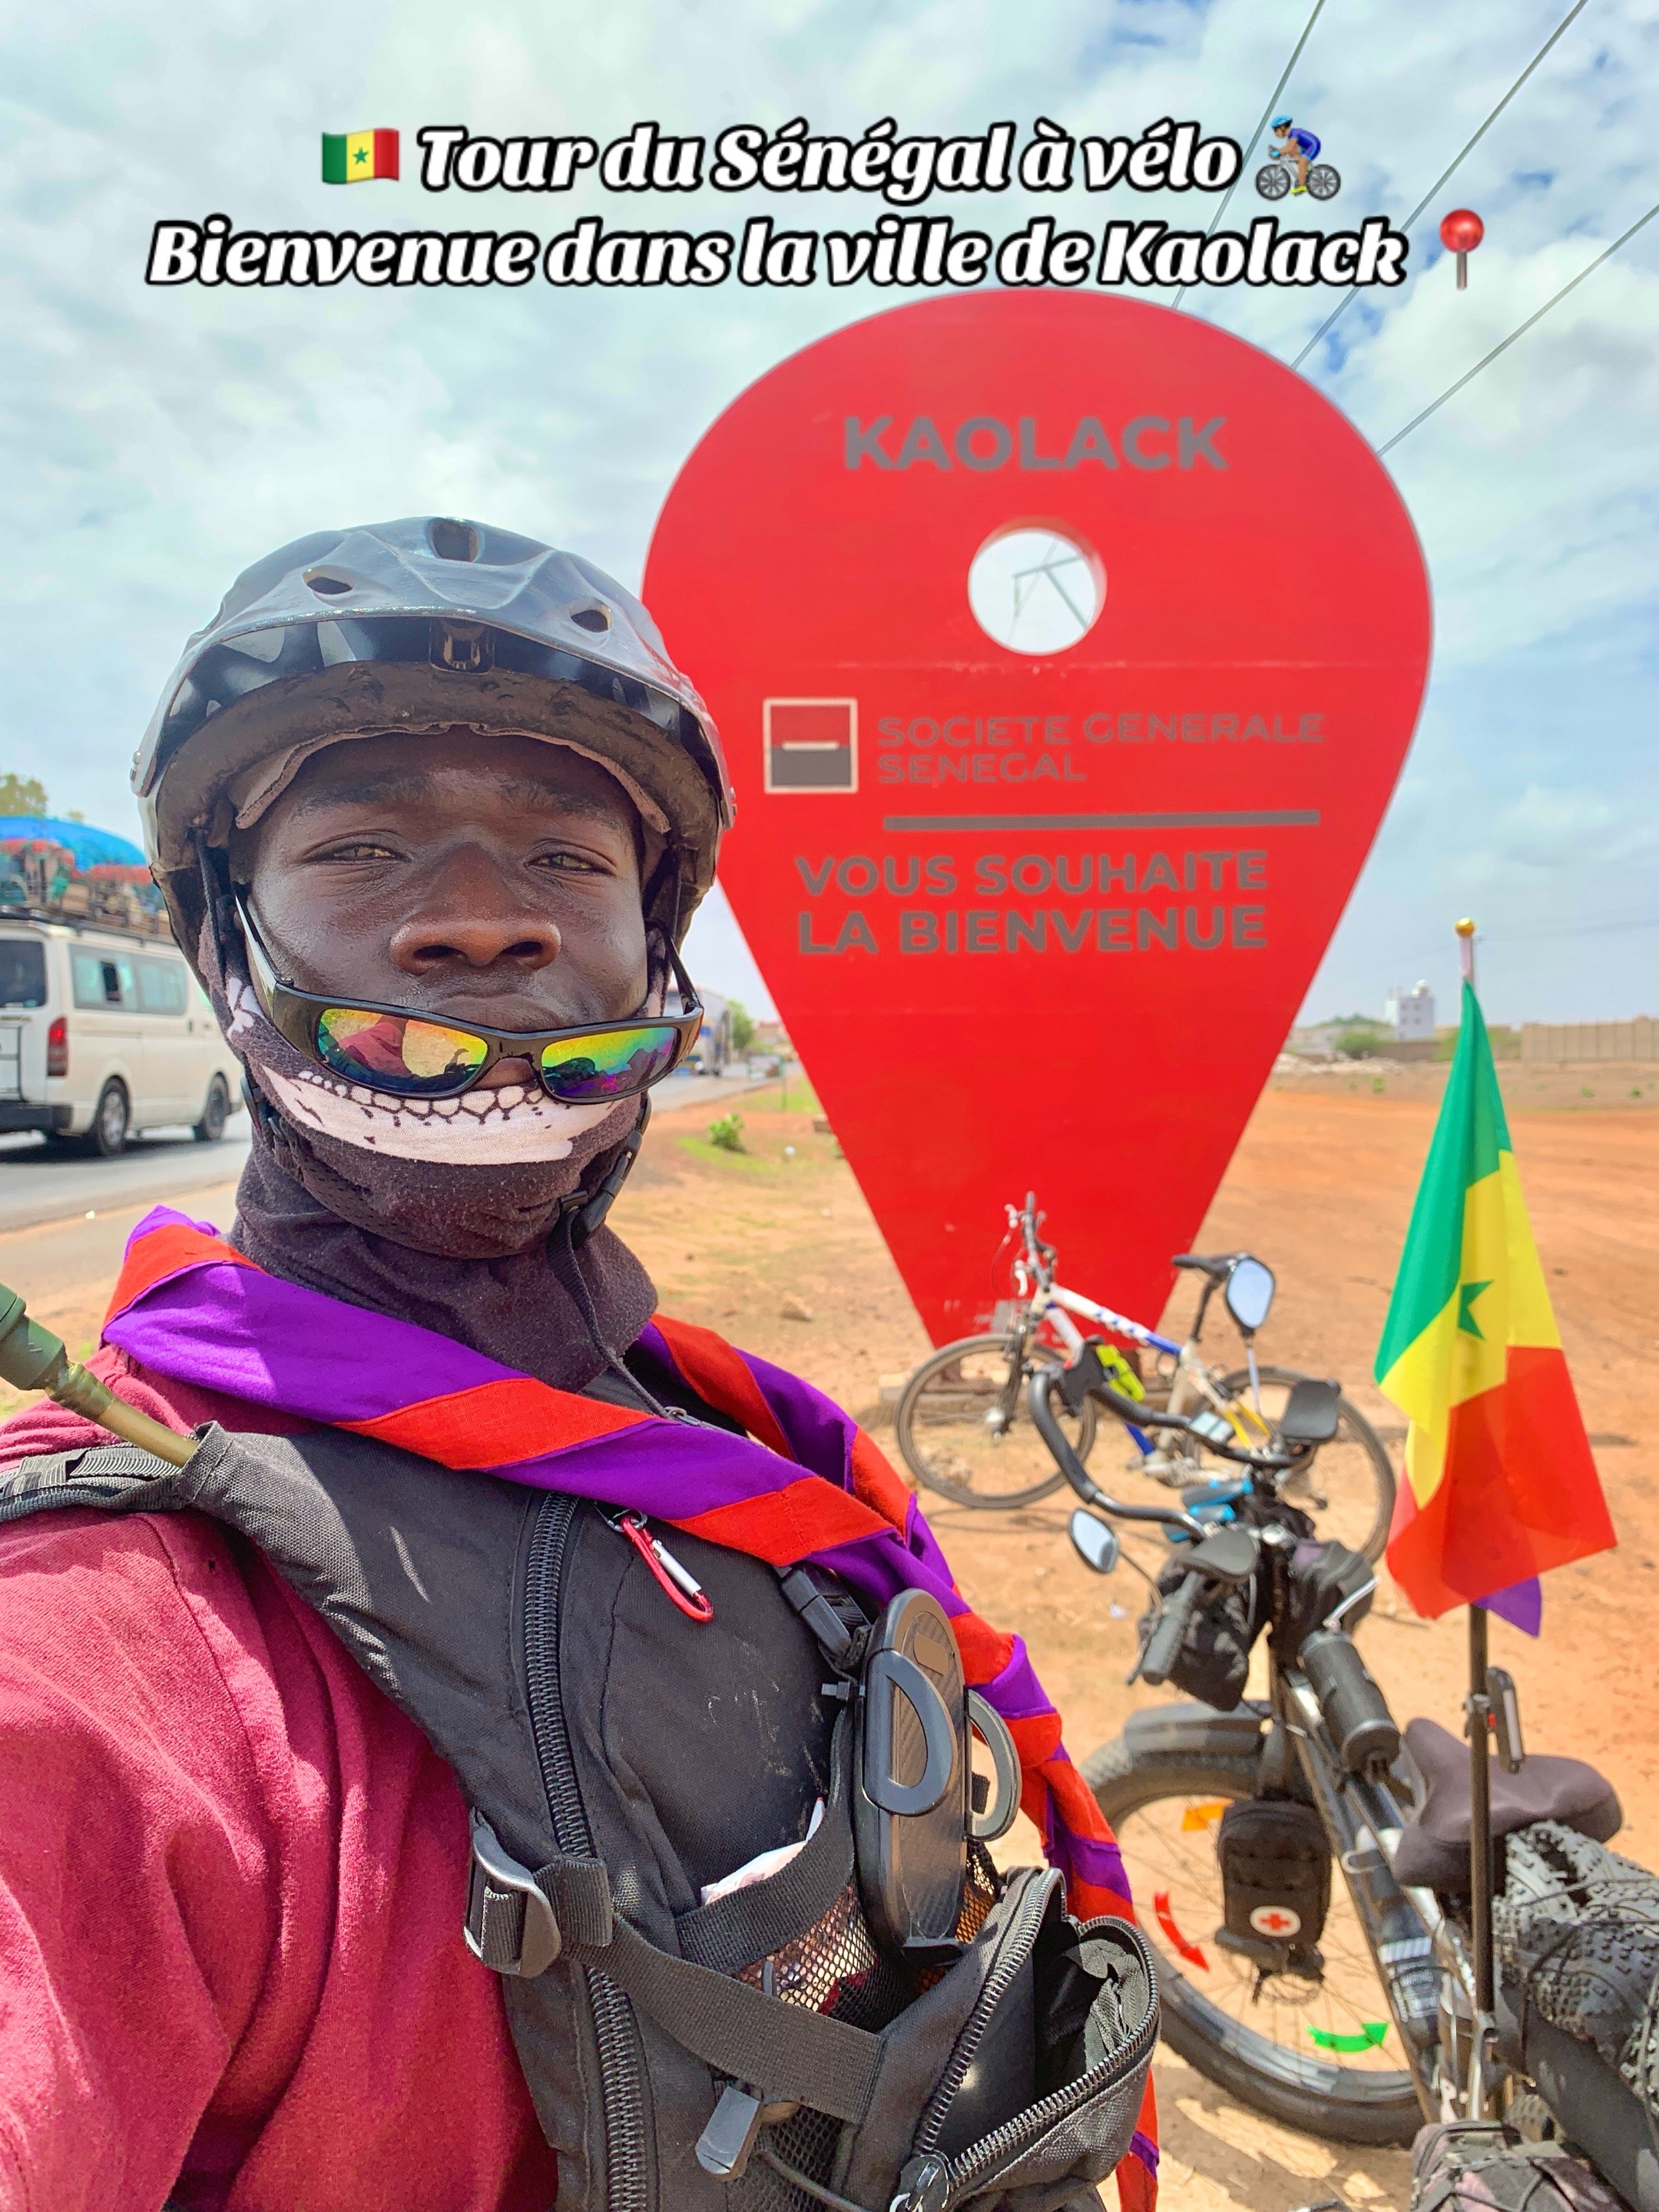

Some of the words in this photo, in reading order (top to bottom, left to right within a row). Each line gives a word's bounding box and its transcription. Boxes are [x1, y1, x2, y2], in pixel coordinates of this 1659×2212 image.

[843, 416, 1230, 472] KAOLACK
[877, 717, 1071, 747] SOCIETE
[1084, 714, 1325, 743] GENERALE
[877, 753, 1088, 784] SENEGAL
[794, 855, 958, 896] VOUS
[975, 849, 1268, 896] SOUHAITE
[798, 911, 879, 955] LA
[899, 905, 1268, 955] BIENVENUE
